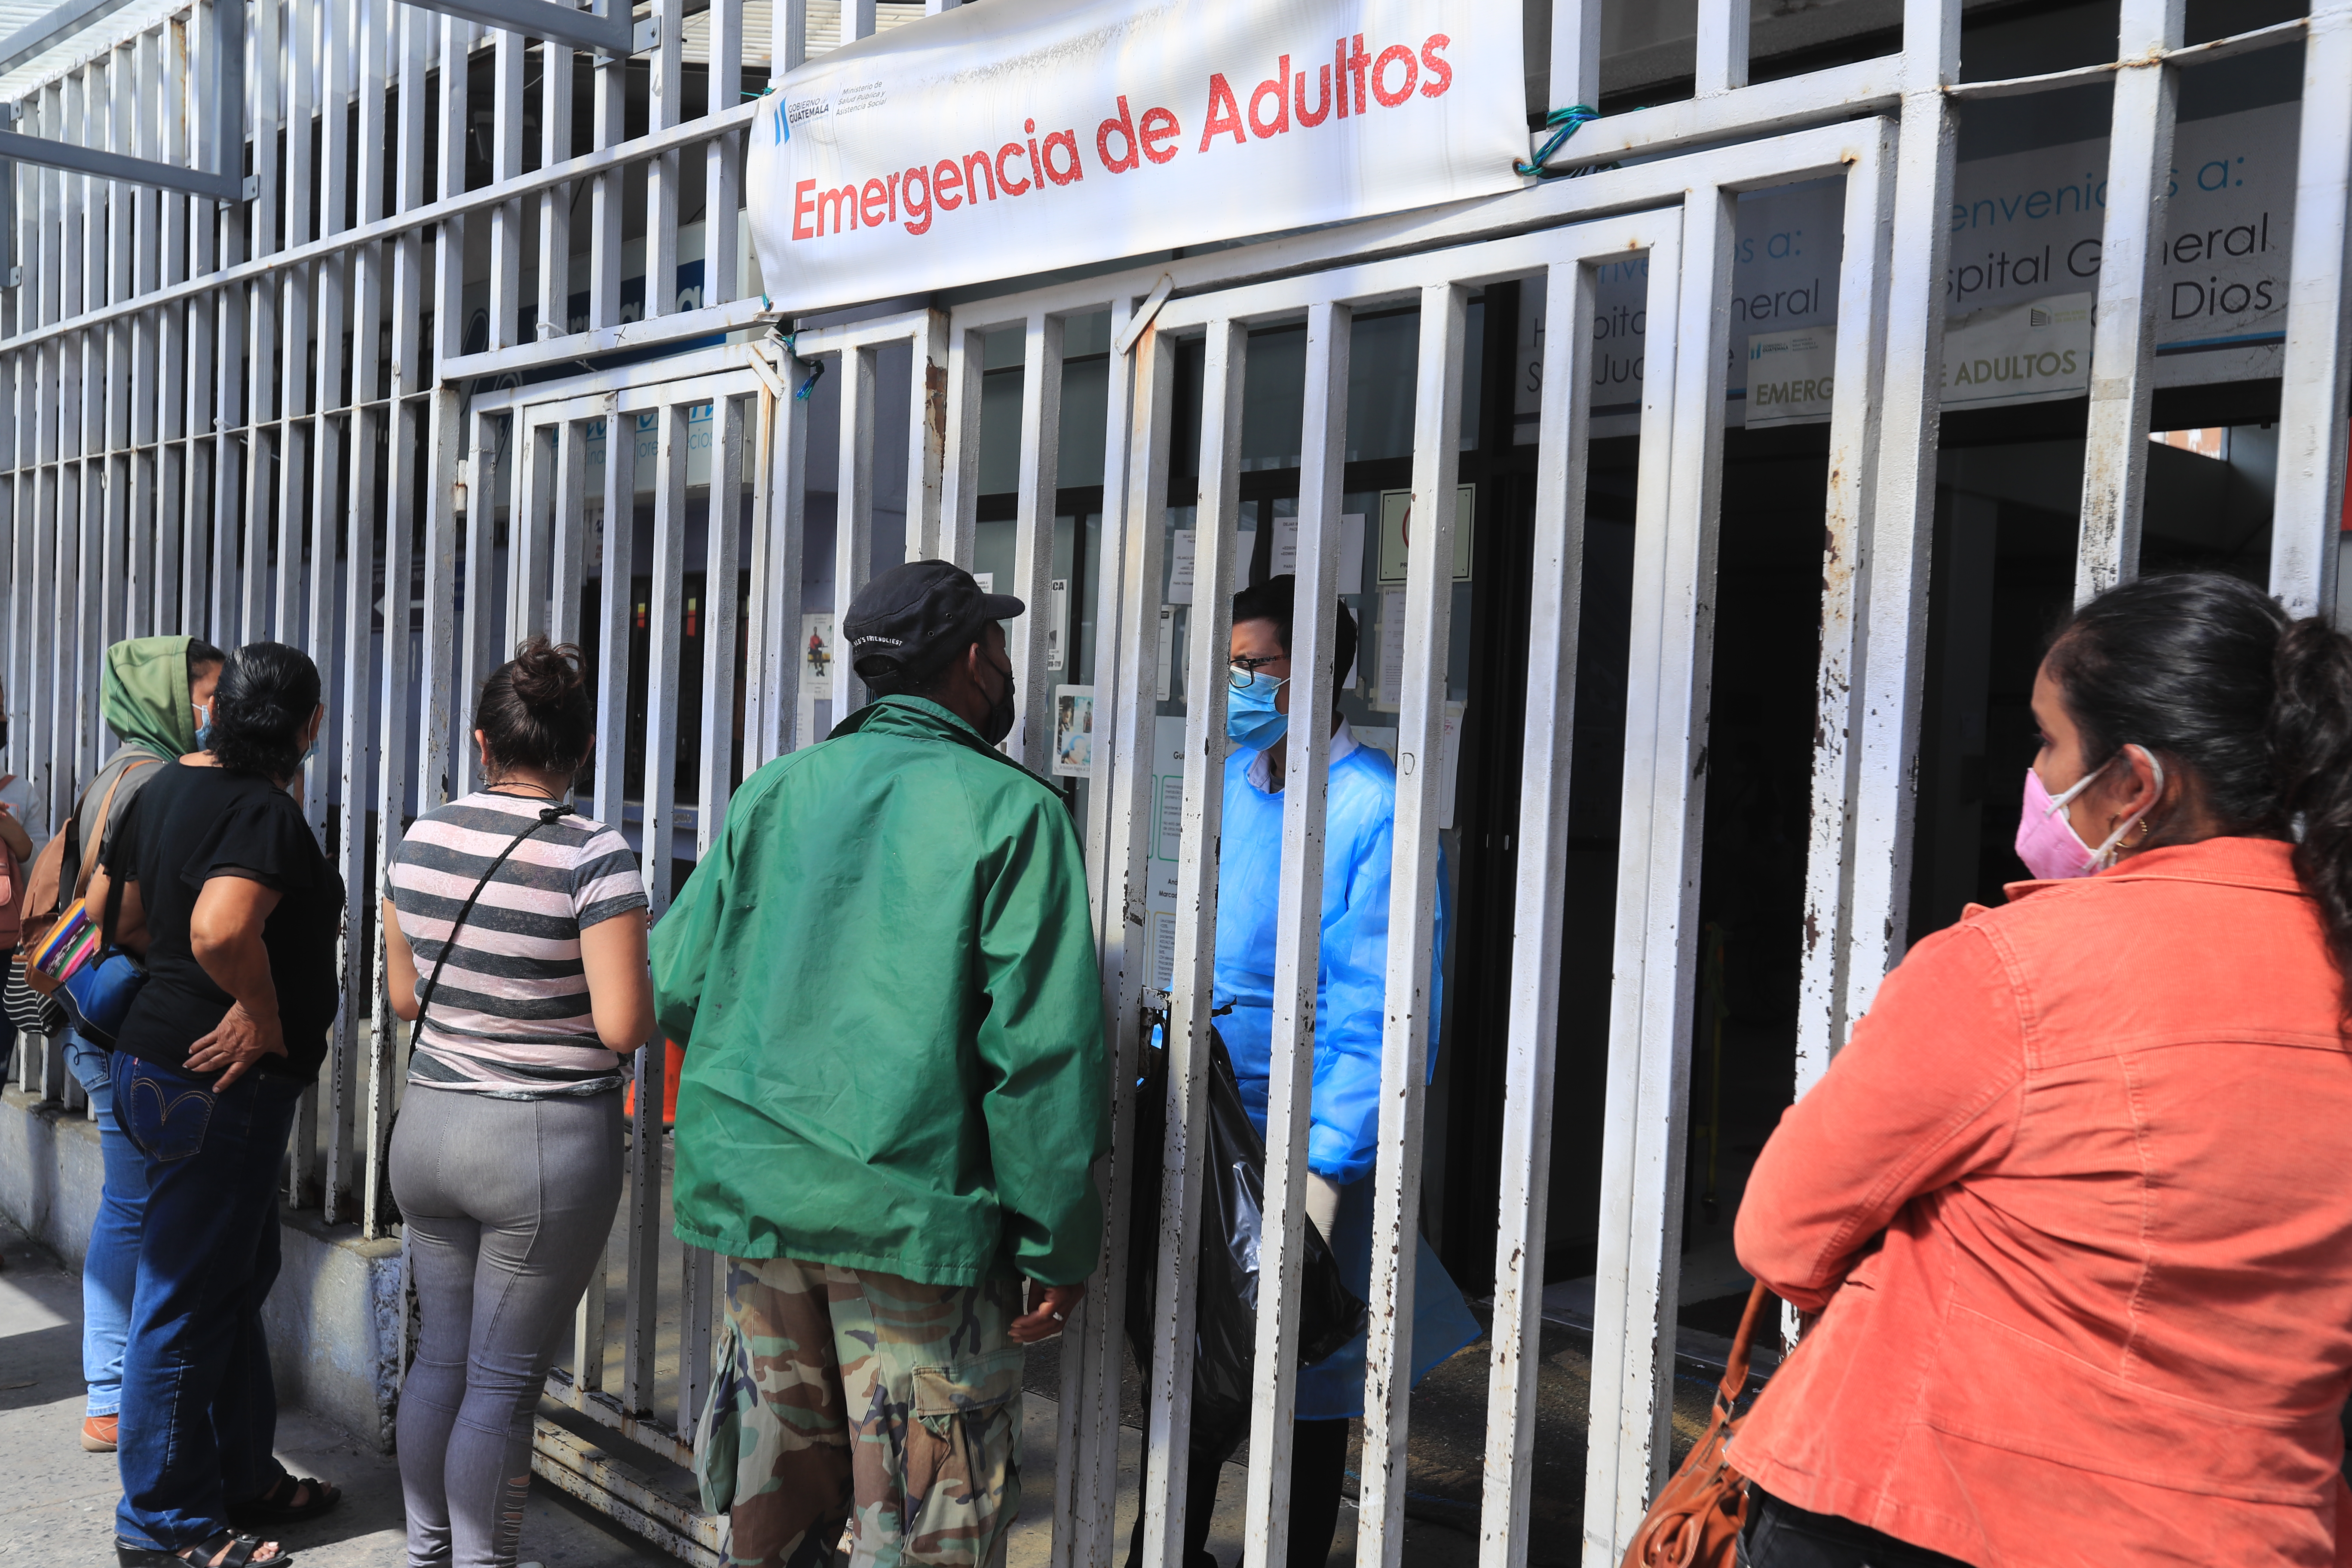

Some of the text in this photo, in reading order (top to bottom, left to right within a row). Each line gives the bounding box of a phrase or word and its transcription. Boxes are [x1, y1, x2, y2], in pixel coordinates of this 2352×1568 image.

[842, 80, 882, 95] Ministerio de
[788, 98, 820, 113] GOBIERNO
[836, 98, 887, 116] Asistencia Social
[838, 96, 856, 105] Salud
[857, 91, 880, 101] Pública
[790, 104, 829, 123] GUATEMALA
[793, 34, 1452, 240] Emergencia de Adultos
[2197, 157, 2245, 191] a:
[1768, 230, 1802, 259] a:
[2171, 276, 2272, 320] Dios
[1756, 377, 1834, 406] EMERG
[1954, 349, 2077, 386] ADULTOS
[866, 635, 903, 646] FRIENDLIEST
